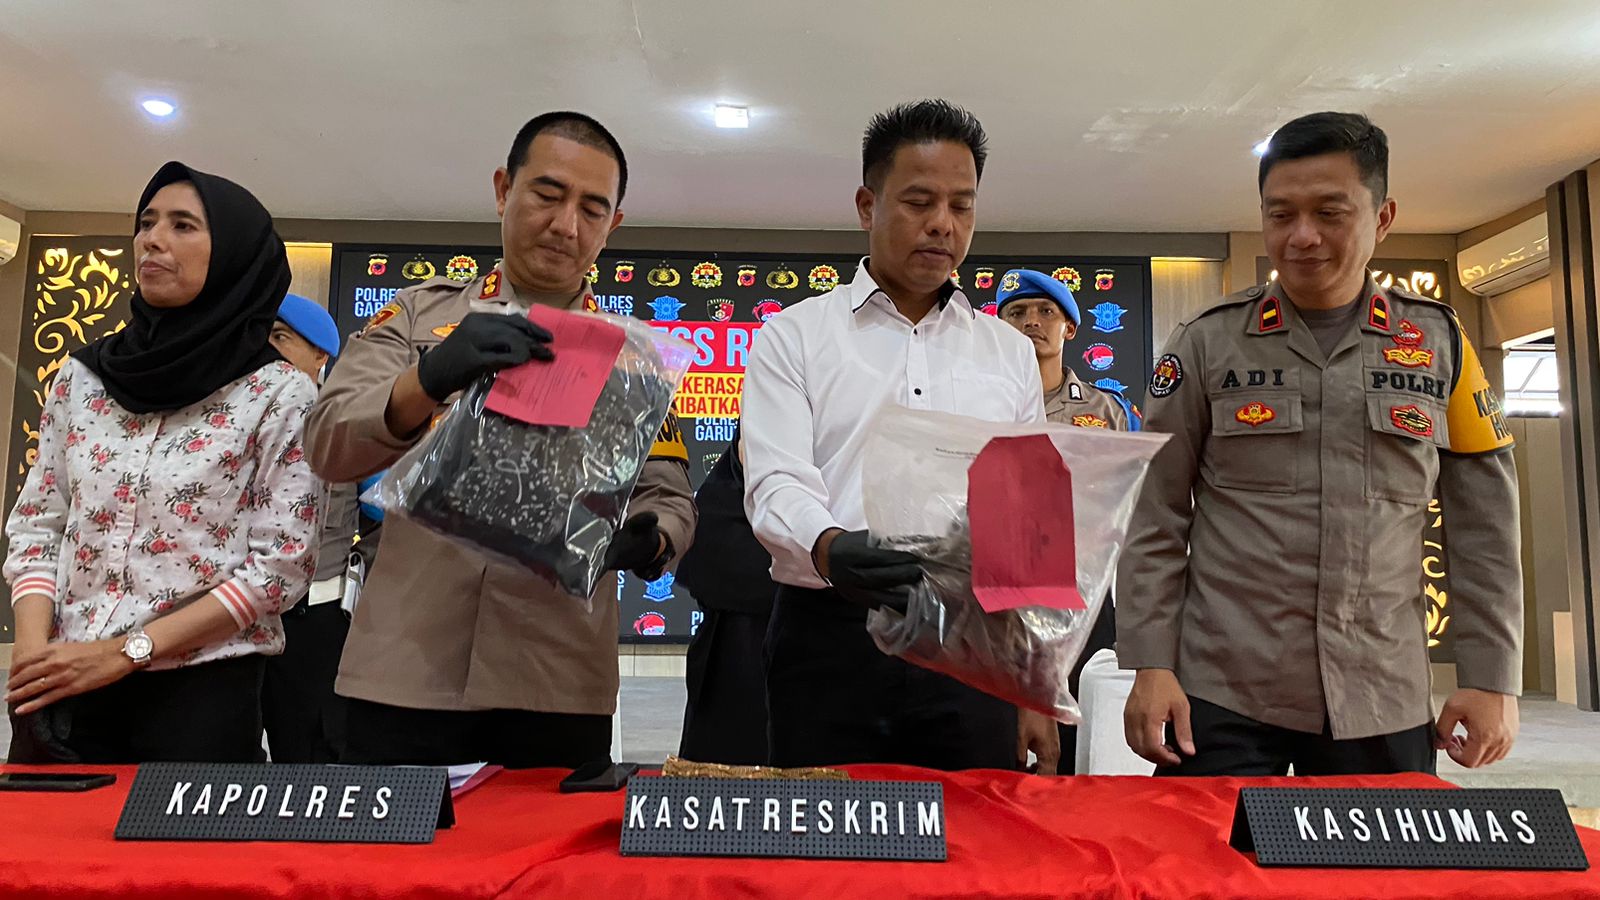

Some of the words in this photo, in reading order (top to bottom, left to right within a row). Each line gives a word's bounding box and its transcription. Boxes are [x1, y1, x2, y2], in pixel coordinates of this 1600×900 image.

[355, 288, 401, 301] POLRE
[594, 295, 633, 309] OLRES
[1222, 369, 1284, 389] ADI
[1371, 371, 1445, 399] POLRI
[695, 425, 737, 441] GARU
[165, 782, 392, 819] KAPOLRES
[1293, 806, 1536, 844] KASIHUMAS
